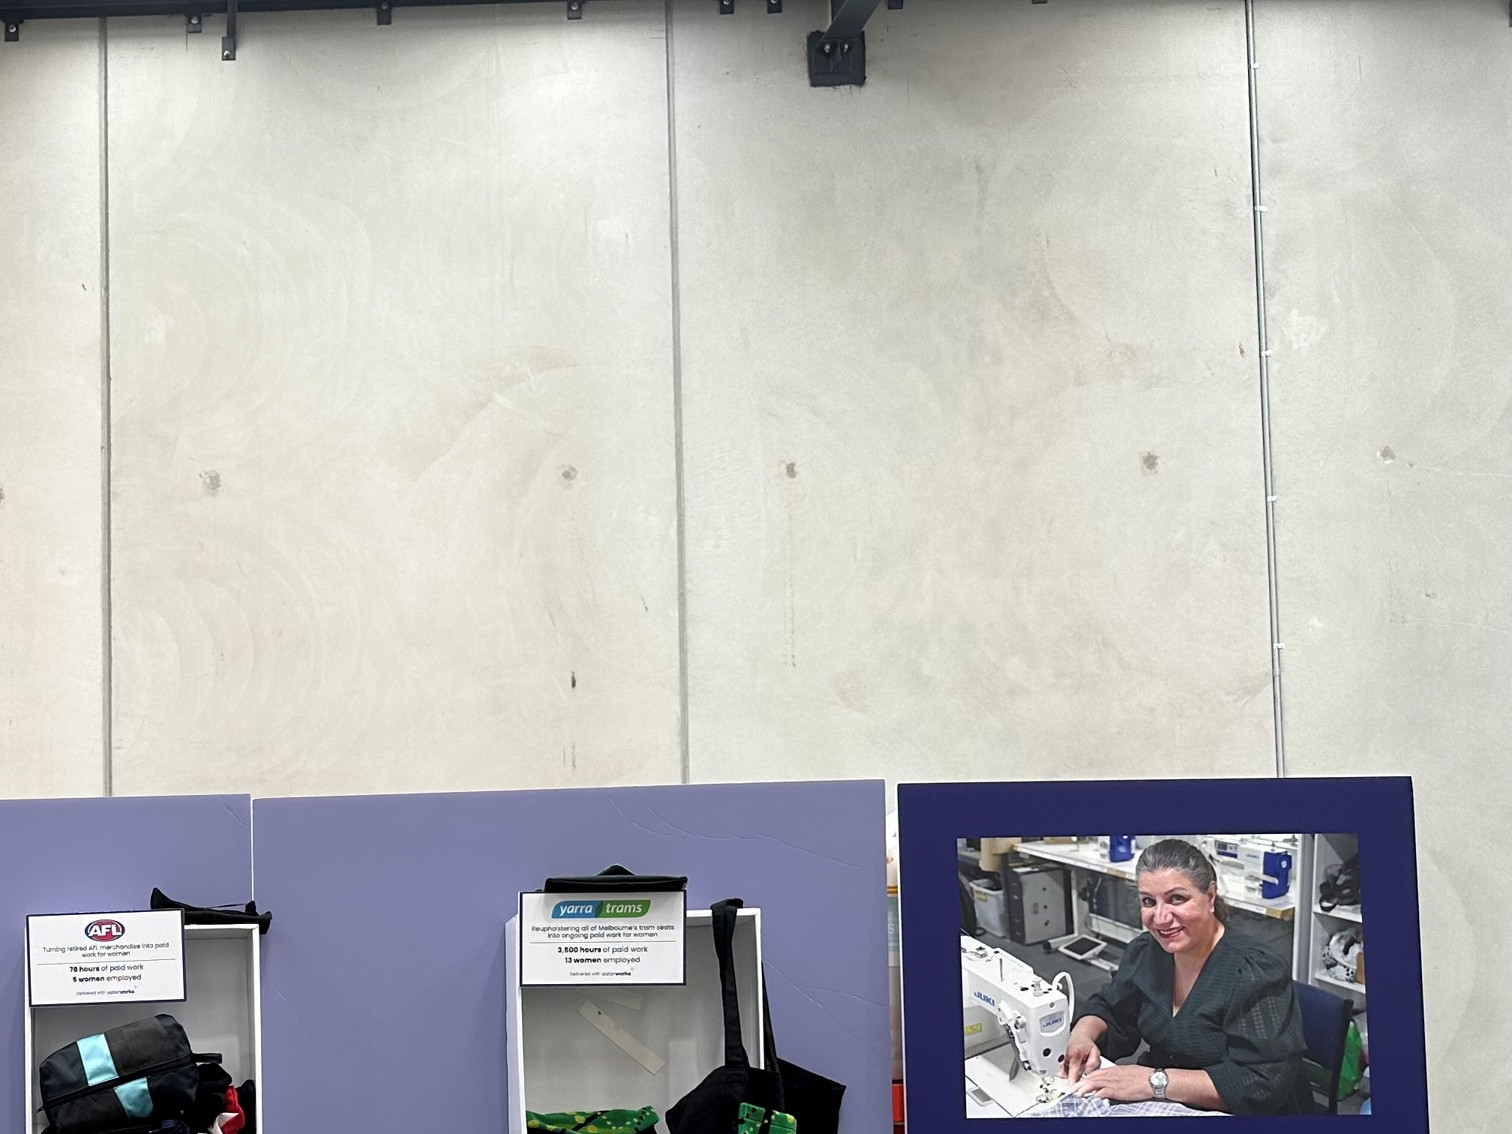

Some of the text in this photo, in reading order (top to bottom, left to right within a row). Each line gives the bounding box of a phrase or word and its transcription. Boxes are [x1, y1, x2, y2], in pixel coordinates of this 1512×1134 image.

[559, 902, 642, 916] yarra trams
[88, 925, 122, 936] AFL
[155, 942, 169, 950] paid
[612, 946, 630, 954] paid
[603, 957, 640, 965] employed
[110, 964, 125, 973] paid
[107, 974, 141, 982] employed
